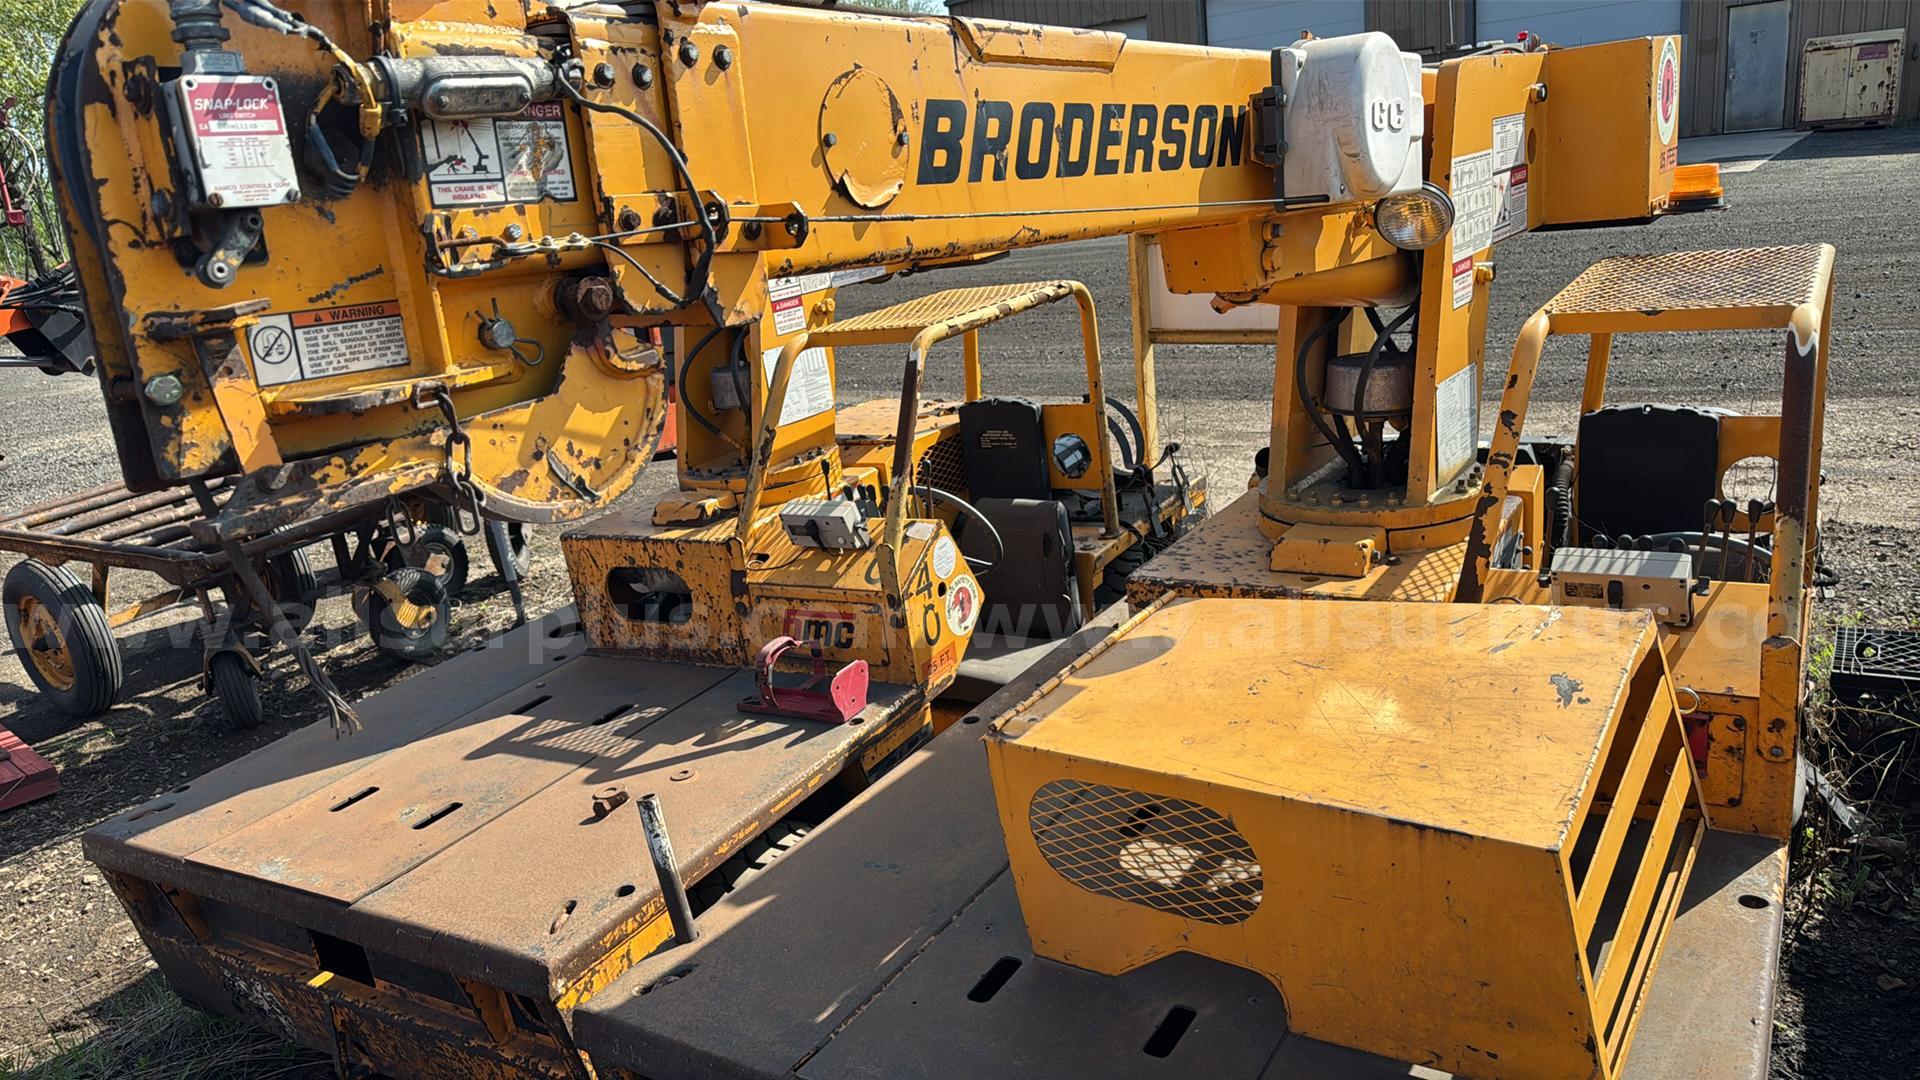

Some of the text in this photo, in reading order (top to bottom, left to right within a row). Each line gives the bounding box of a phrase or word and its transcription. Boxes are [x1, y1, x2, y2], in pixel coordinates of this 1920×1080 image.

[916, 99, 1247, 185] BRODERSON
[781, 298, 800, 310] DANGER
[329, 305, 385, 320] WARNING
[340, 336, 373, 344] SERIOUSLY
[927, 660, 938, 676] 25
